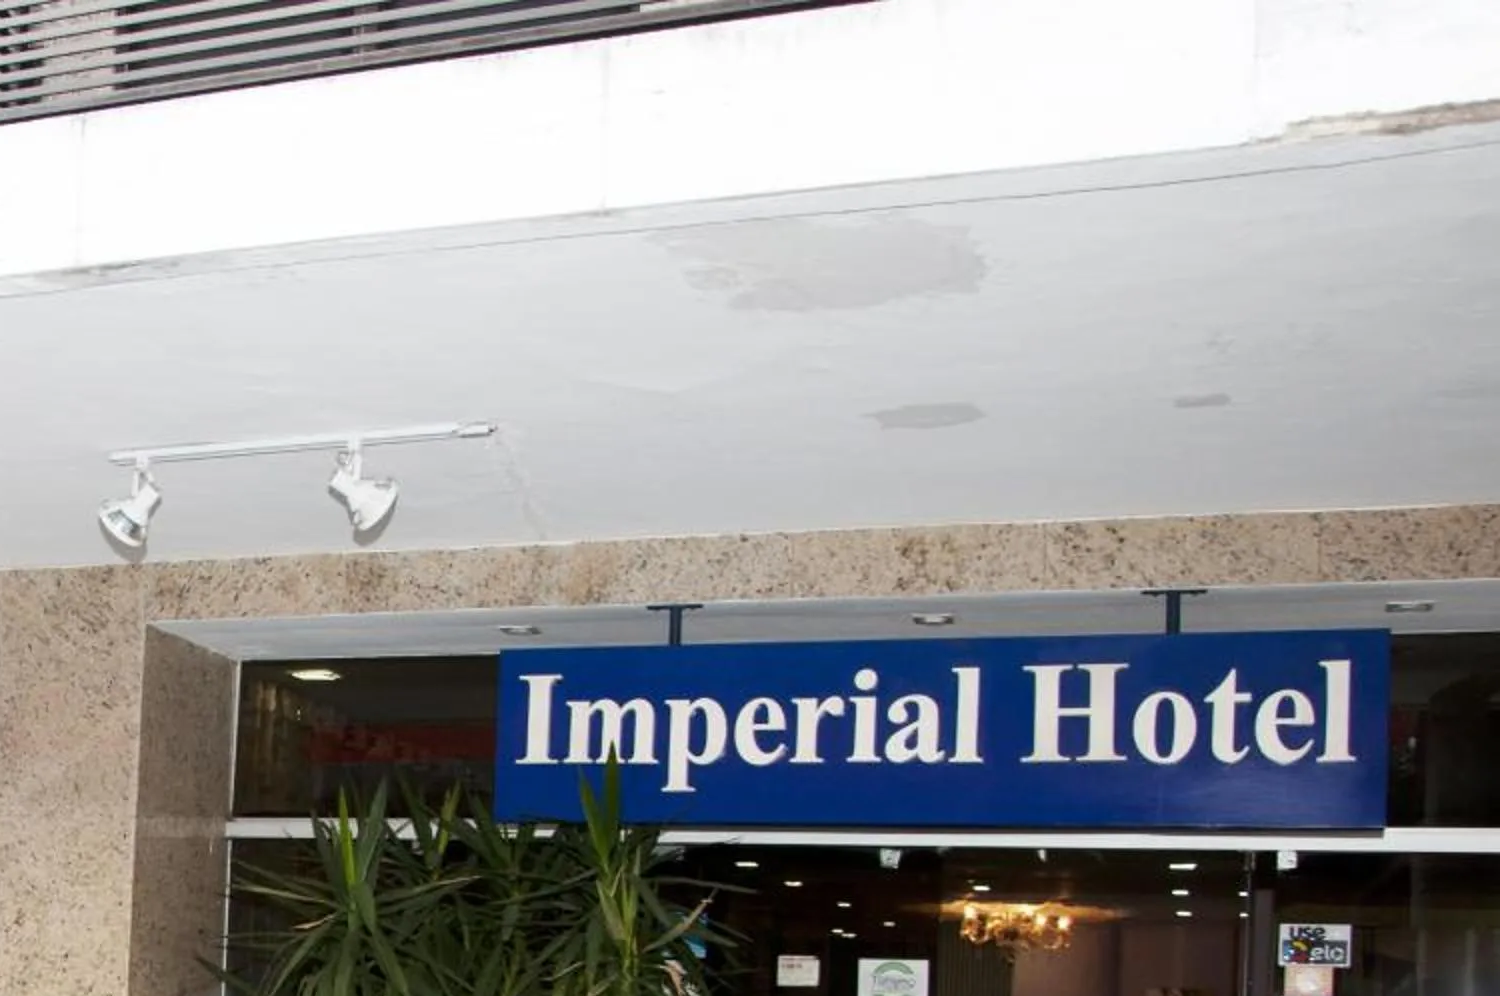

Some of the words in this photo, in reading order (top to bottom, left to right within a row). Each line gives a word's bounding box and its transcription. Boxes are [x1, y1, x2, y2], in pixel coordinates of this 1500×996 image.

[514, 666, 985, 793] Imperial
[1020, 658, 1357, 766] Hotel
[1288, 924, 1327, 941] use
[1310, 942, 1346, 962] elo
